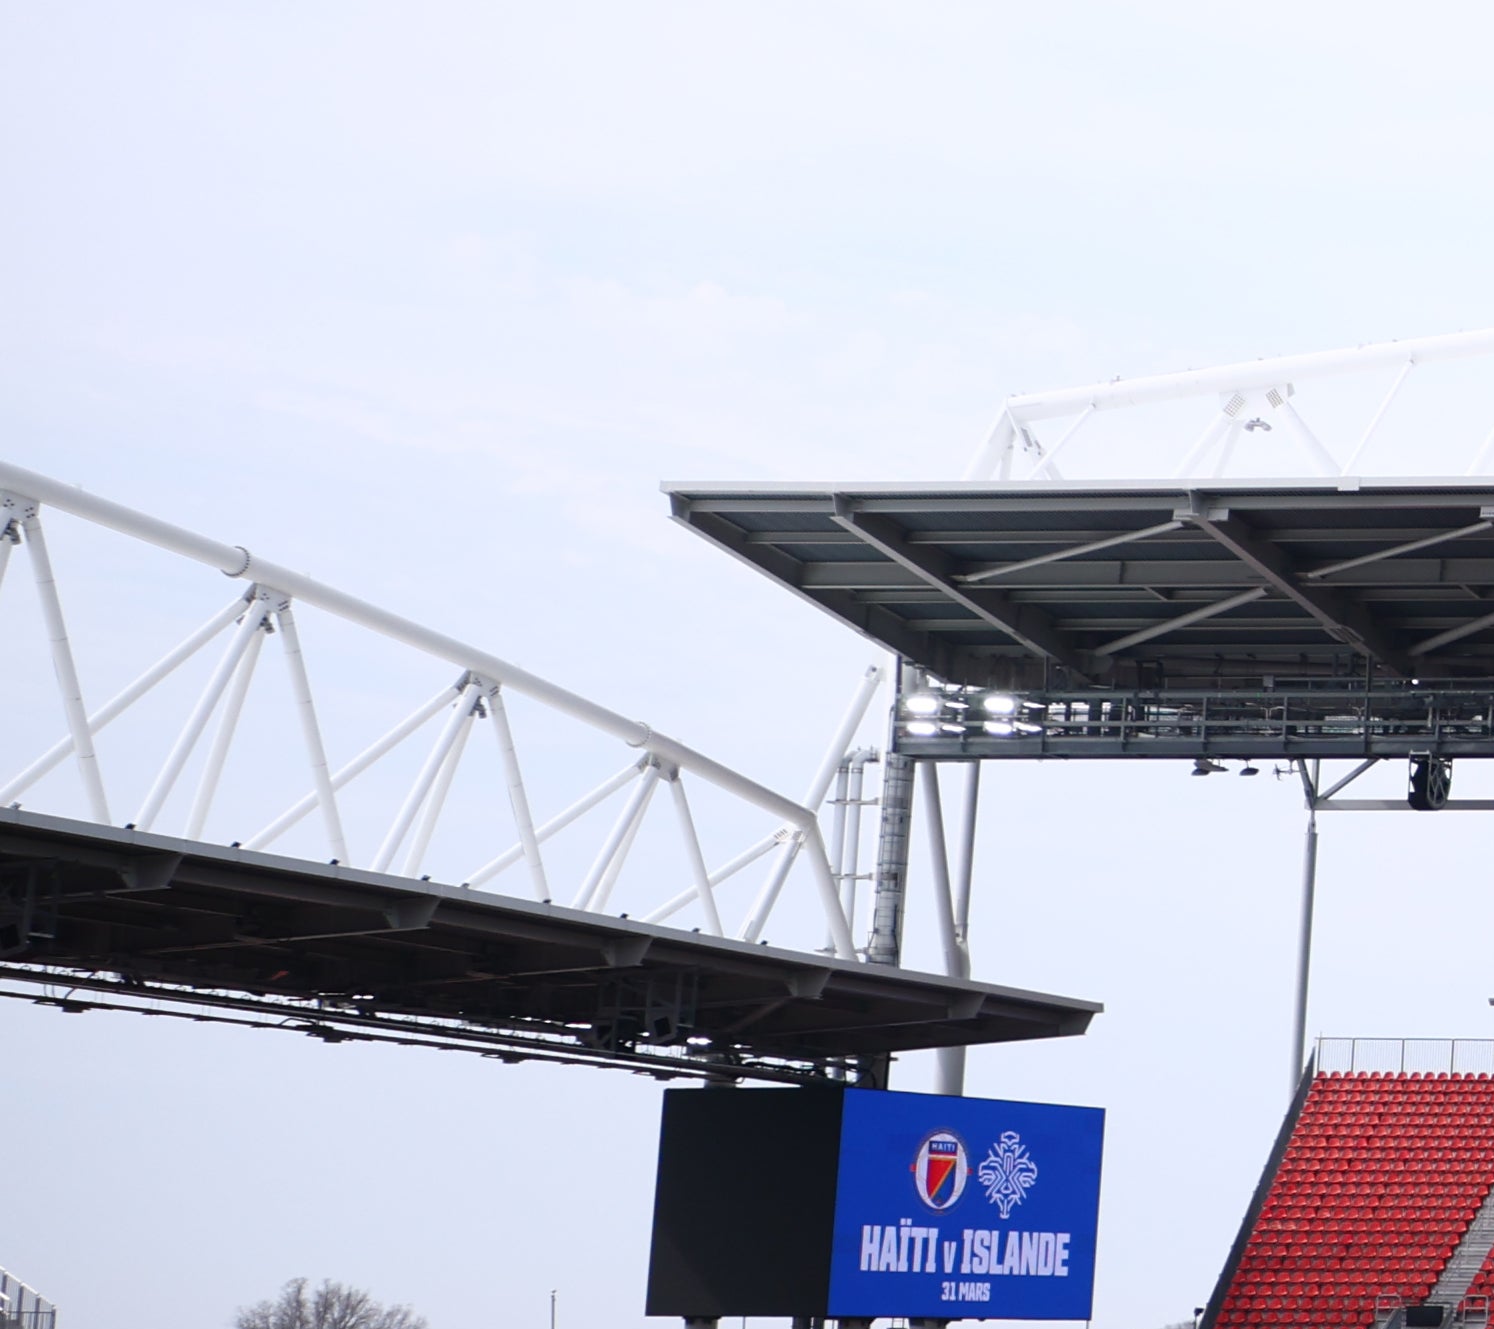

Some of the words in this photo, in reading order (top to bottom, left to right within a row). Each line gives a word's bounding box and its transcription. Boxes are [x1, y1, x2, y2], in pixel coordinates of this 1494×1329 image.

[932, 1142, 956, 1153] HAITI
[860, 1218, 938, 1273] HAÏTI
[943, 1241, 957, 1273] v
[961, 1228, 1070, 1277] ISLANDE
[941, 1281, 956, 1301] 31
[958, 1282, 991, 1302] MARS
